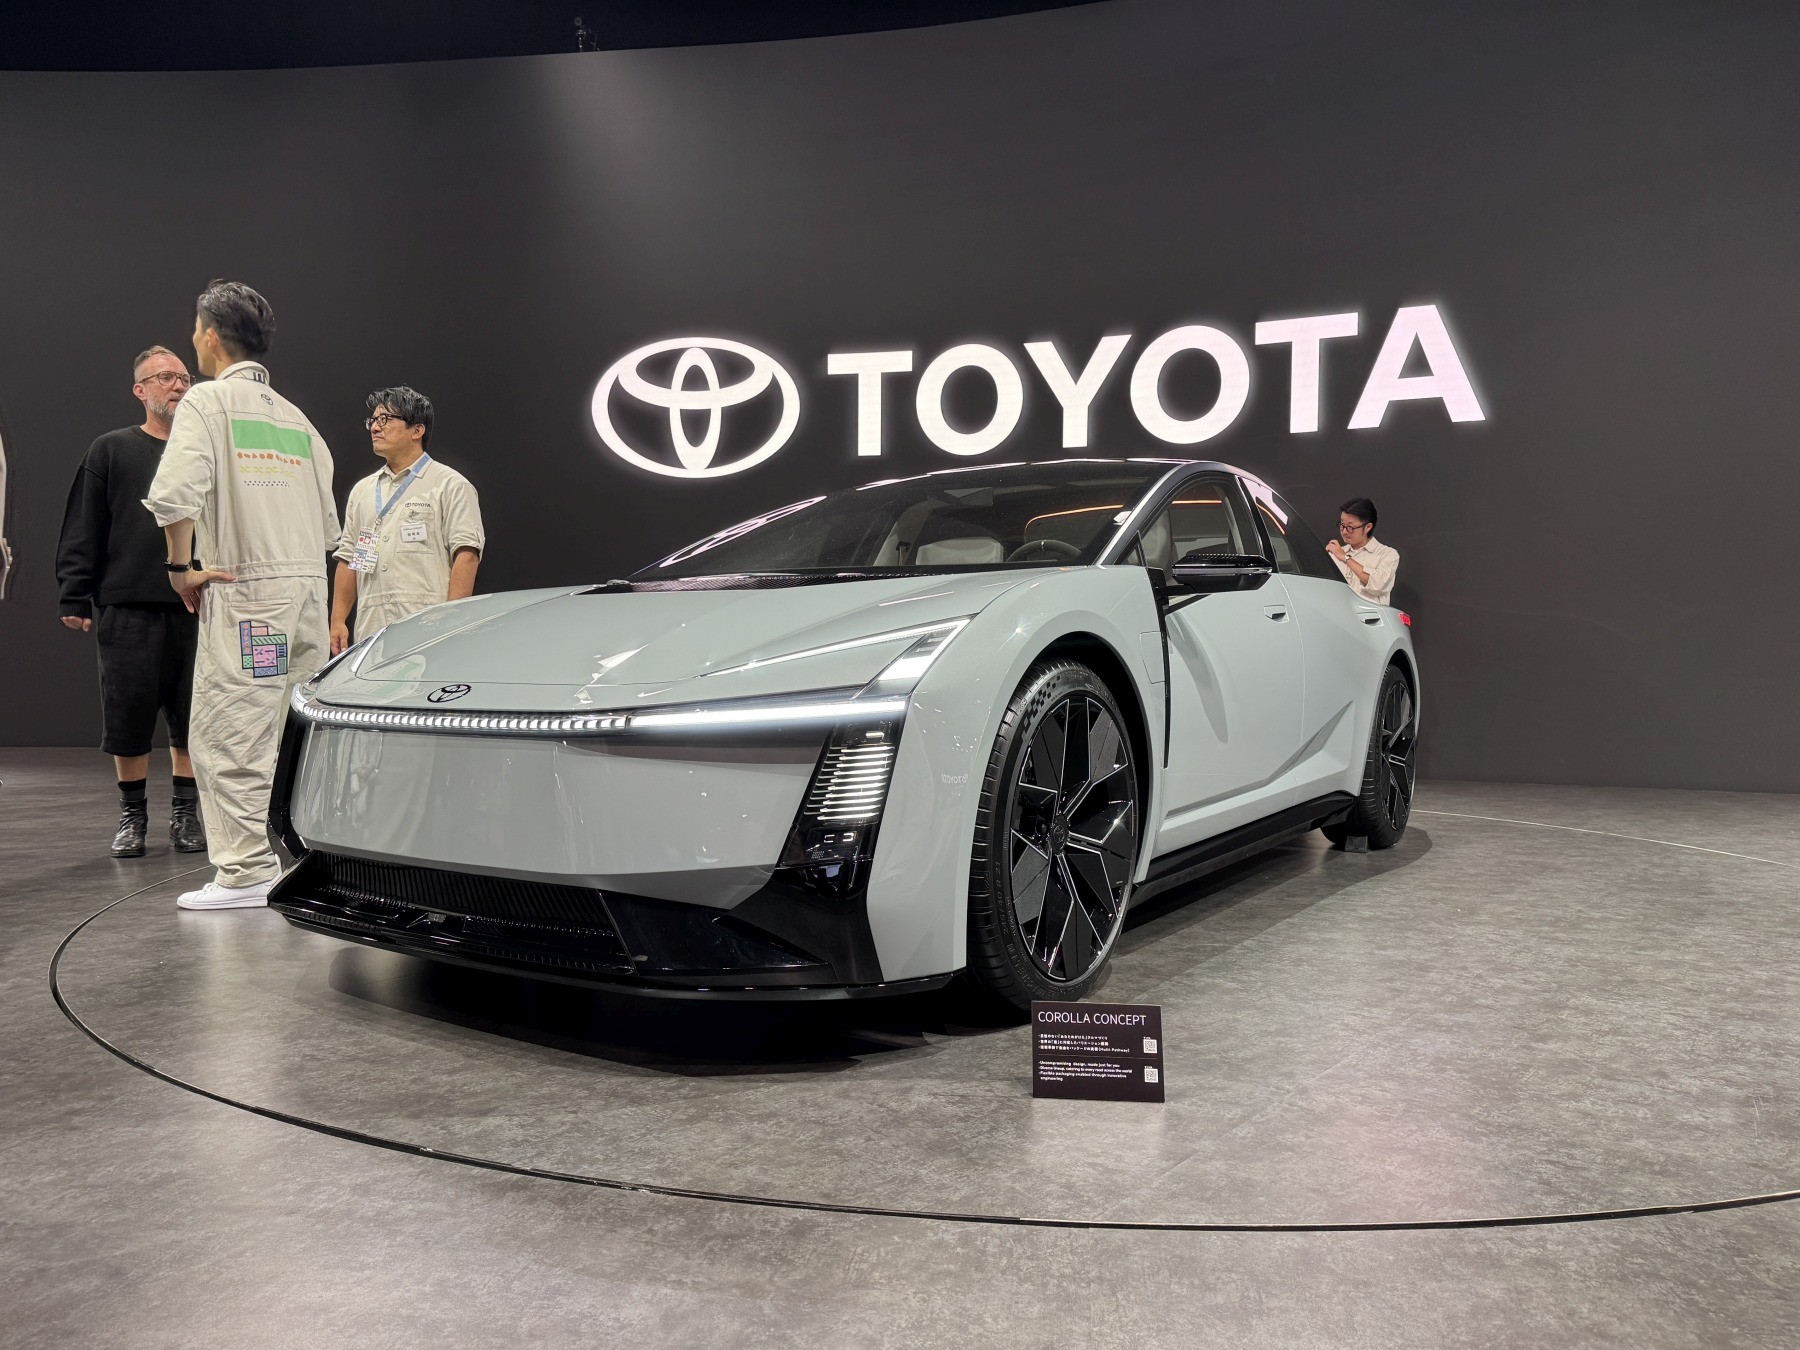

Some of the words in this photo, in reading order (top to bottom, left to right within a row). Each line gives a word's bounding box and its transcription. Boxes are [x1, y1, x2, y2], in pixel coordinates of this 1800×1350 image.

[828, 304, 1486, 457] TOYOTA
[1038, 1011, 1091, 1024] COROLLA
[1093, 1013, 1147, 1026] CONCEPT
